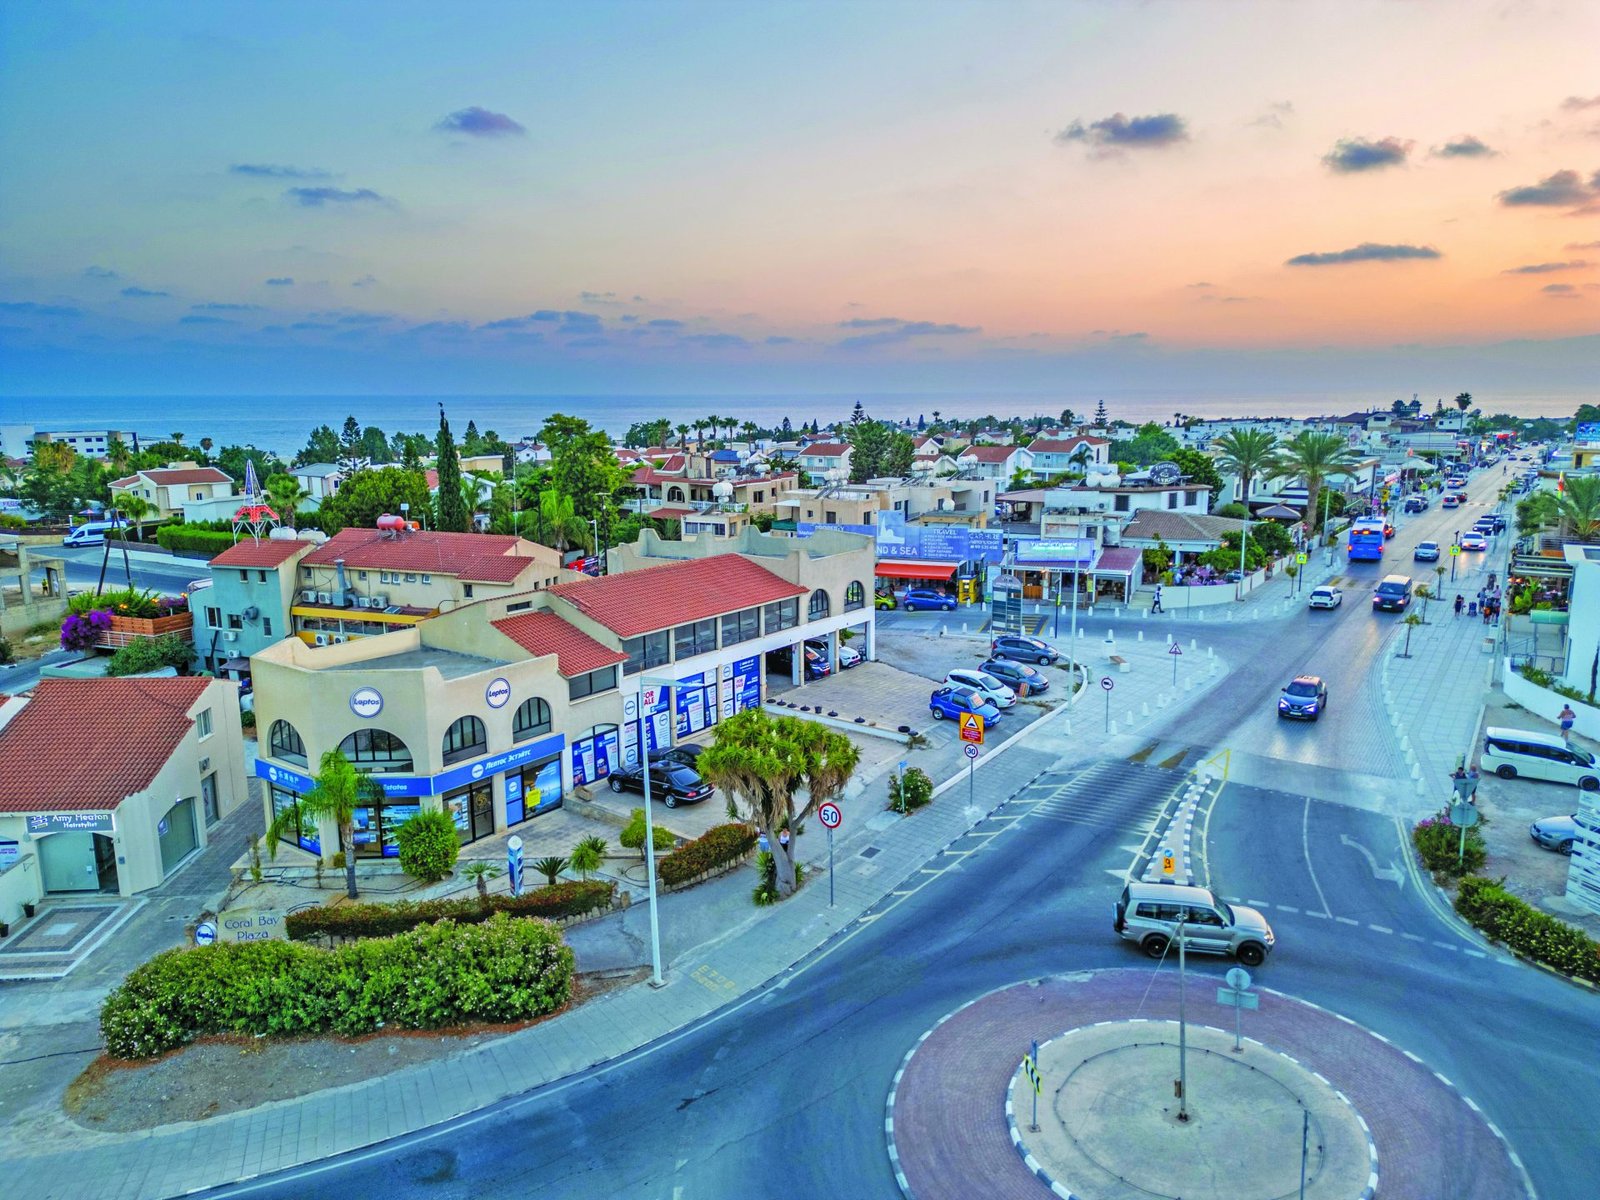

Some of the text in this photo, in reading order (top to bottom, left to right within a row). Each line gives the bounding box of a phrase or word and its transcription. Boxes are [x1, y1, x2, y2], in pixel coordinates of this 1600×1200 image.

[875, 546, 889, 554] ND
[890, 546, 898, 555] &
[899, 546, 918, 555] SEA
[488, 688, 508, 698] Leptos
[353, 698, 380, 707] Leptos
[643, 697, 655, 706] ALE
[966, 747, 976, 756] 30
[52, 813, 109, 823] Amy Heaton
[822, 809, 838, 824] 50
[63, 821, 97, 829] Hairstylist
[224, 915, 280, 930] Coral Bay
[237, 931, 269, 941] Plaza
